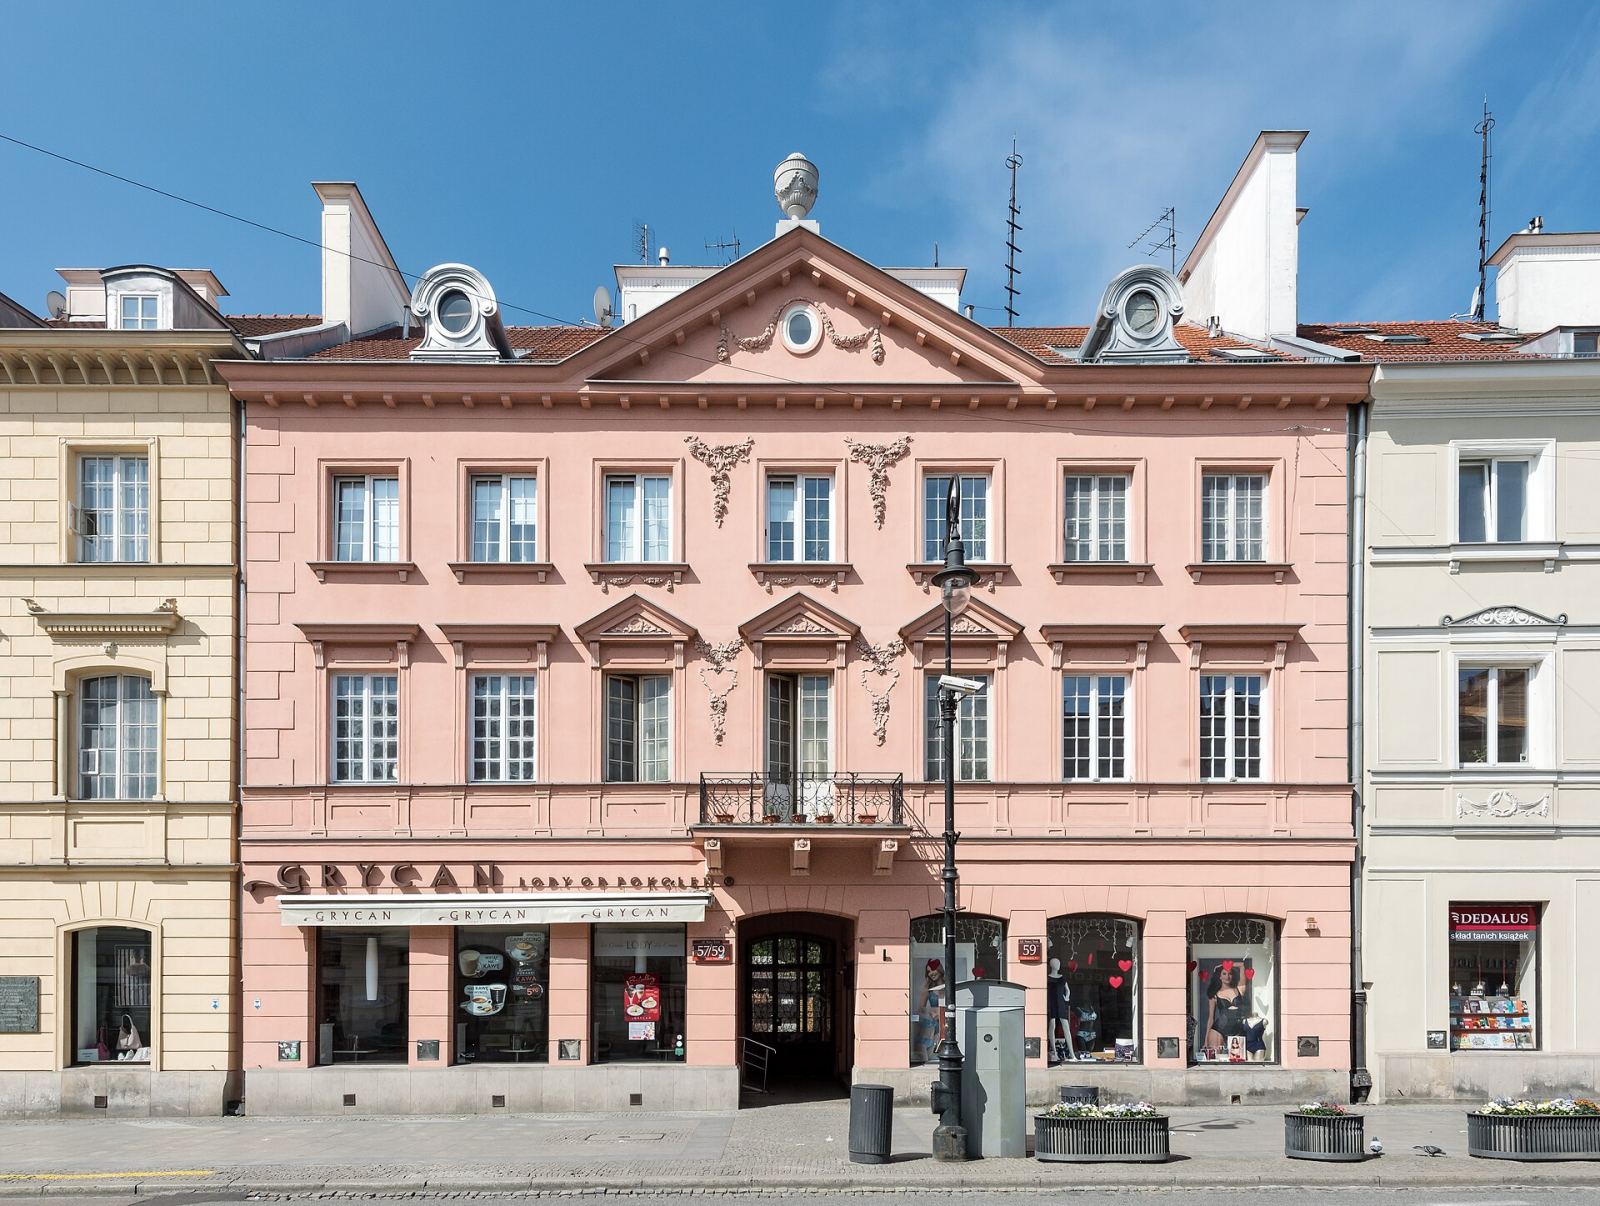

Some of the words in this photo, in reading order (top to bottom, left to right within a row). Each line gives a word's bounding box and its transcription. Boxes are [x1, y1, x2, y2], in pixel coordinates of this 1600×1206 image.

[277, 863, 497, 893] GRYCAN
[519, 876, 573, 888] LODY
[581, 876, 608, 888] OD
[316, 910, 392, 922] GRYCAN
[450, 910, 526, 921] GRYCAN
[593, 908, 669, 918] GRYCAN
[1460, 913, 1529, 924] DEDALUS
[1450, 932, 1472, 940] skład
[1473, 932, 1497, 940] tanich
[1498, 932, 1529, 941] książek
[697, 945, 725, 958] 57/59
[1022, 944, 1037, 956] 59
